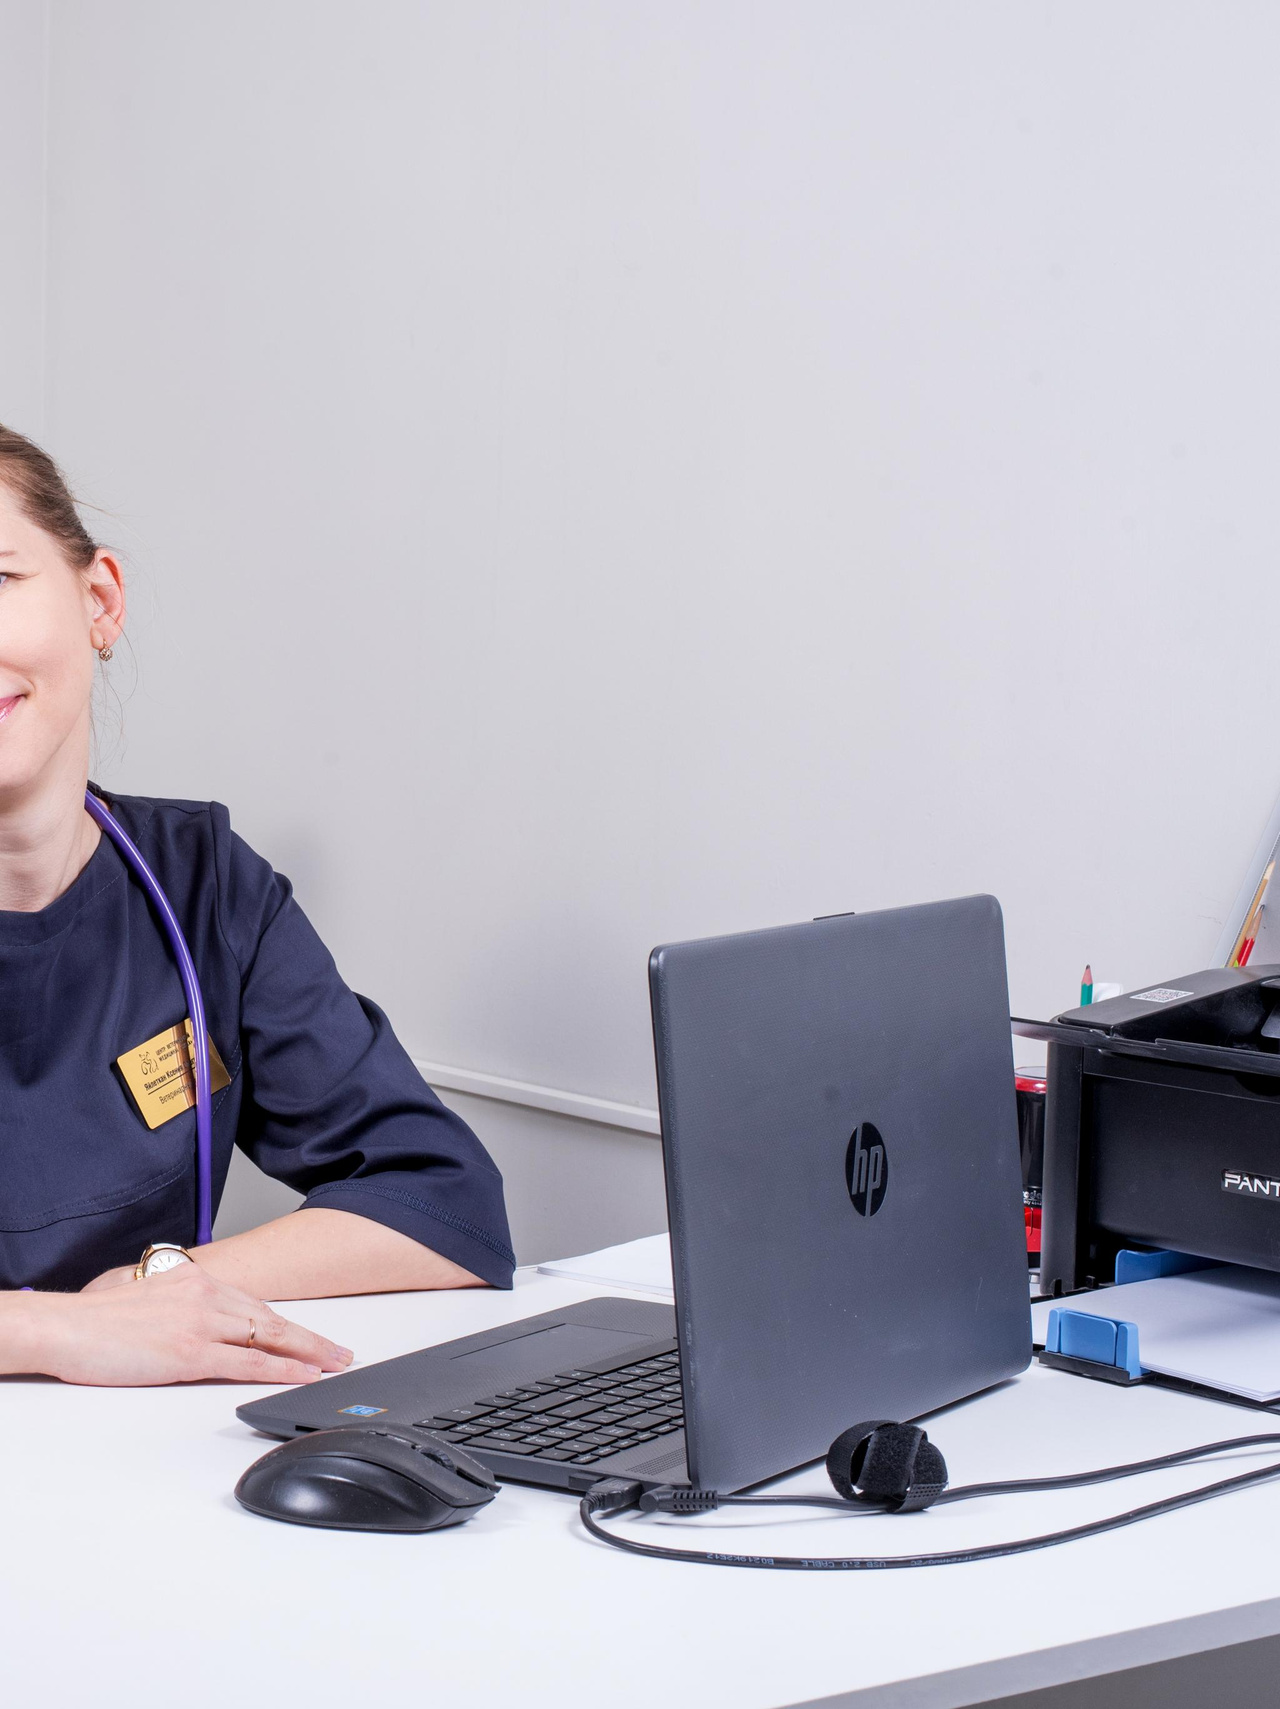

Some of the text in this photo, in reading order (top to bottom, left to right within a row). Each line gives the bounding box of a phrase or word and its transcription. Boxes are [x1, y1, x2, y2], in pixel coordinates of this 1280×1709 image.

[851, 1122, 884, 1217] hp
[1224, 1172, 1280, 1197] PANT
[800, 1559, 835, 1568] CABLE
[842, 1560, 861, 1568] 2.0
[866, 1560, 887, 1568] USB
